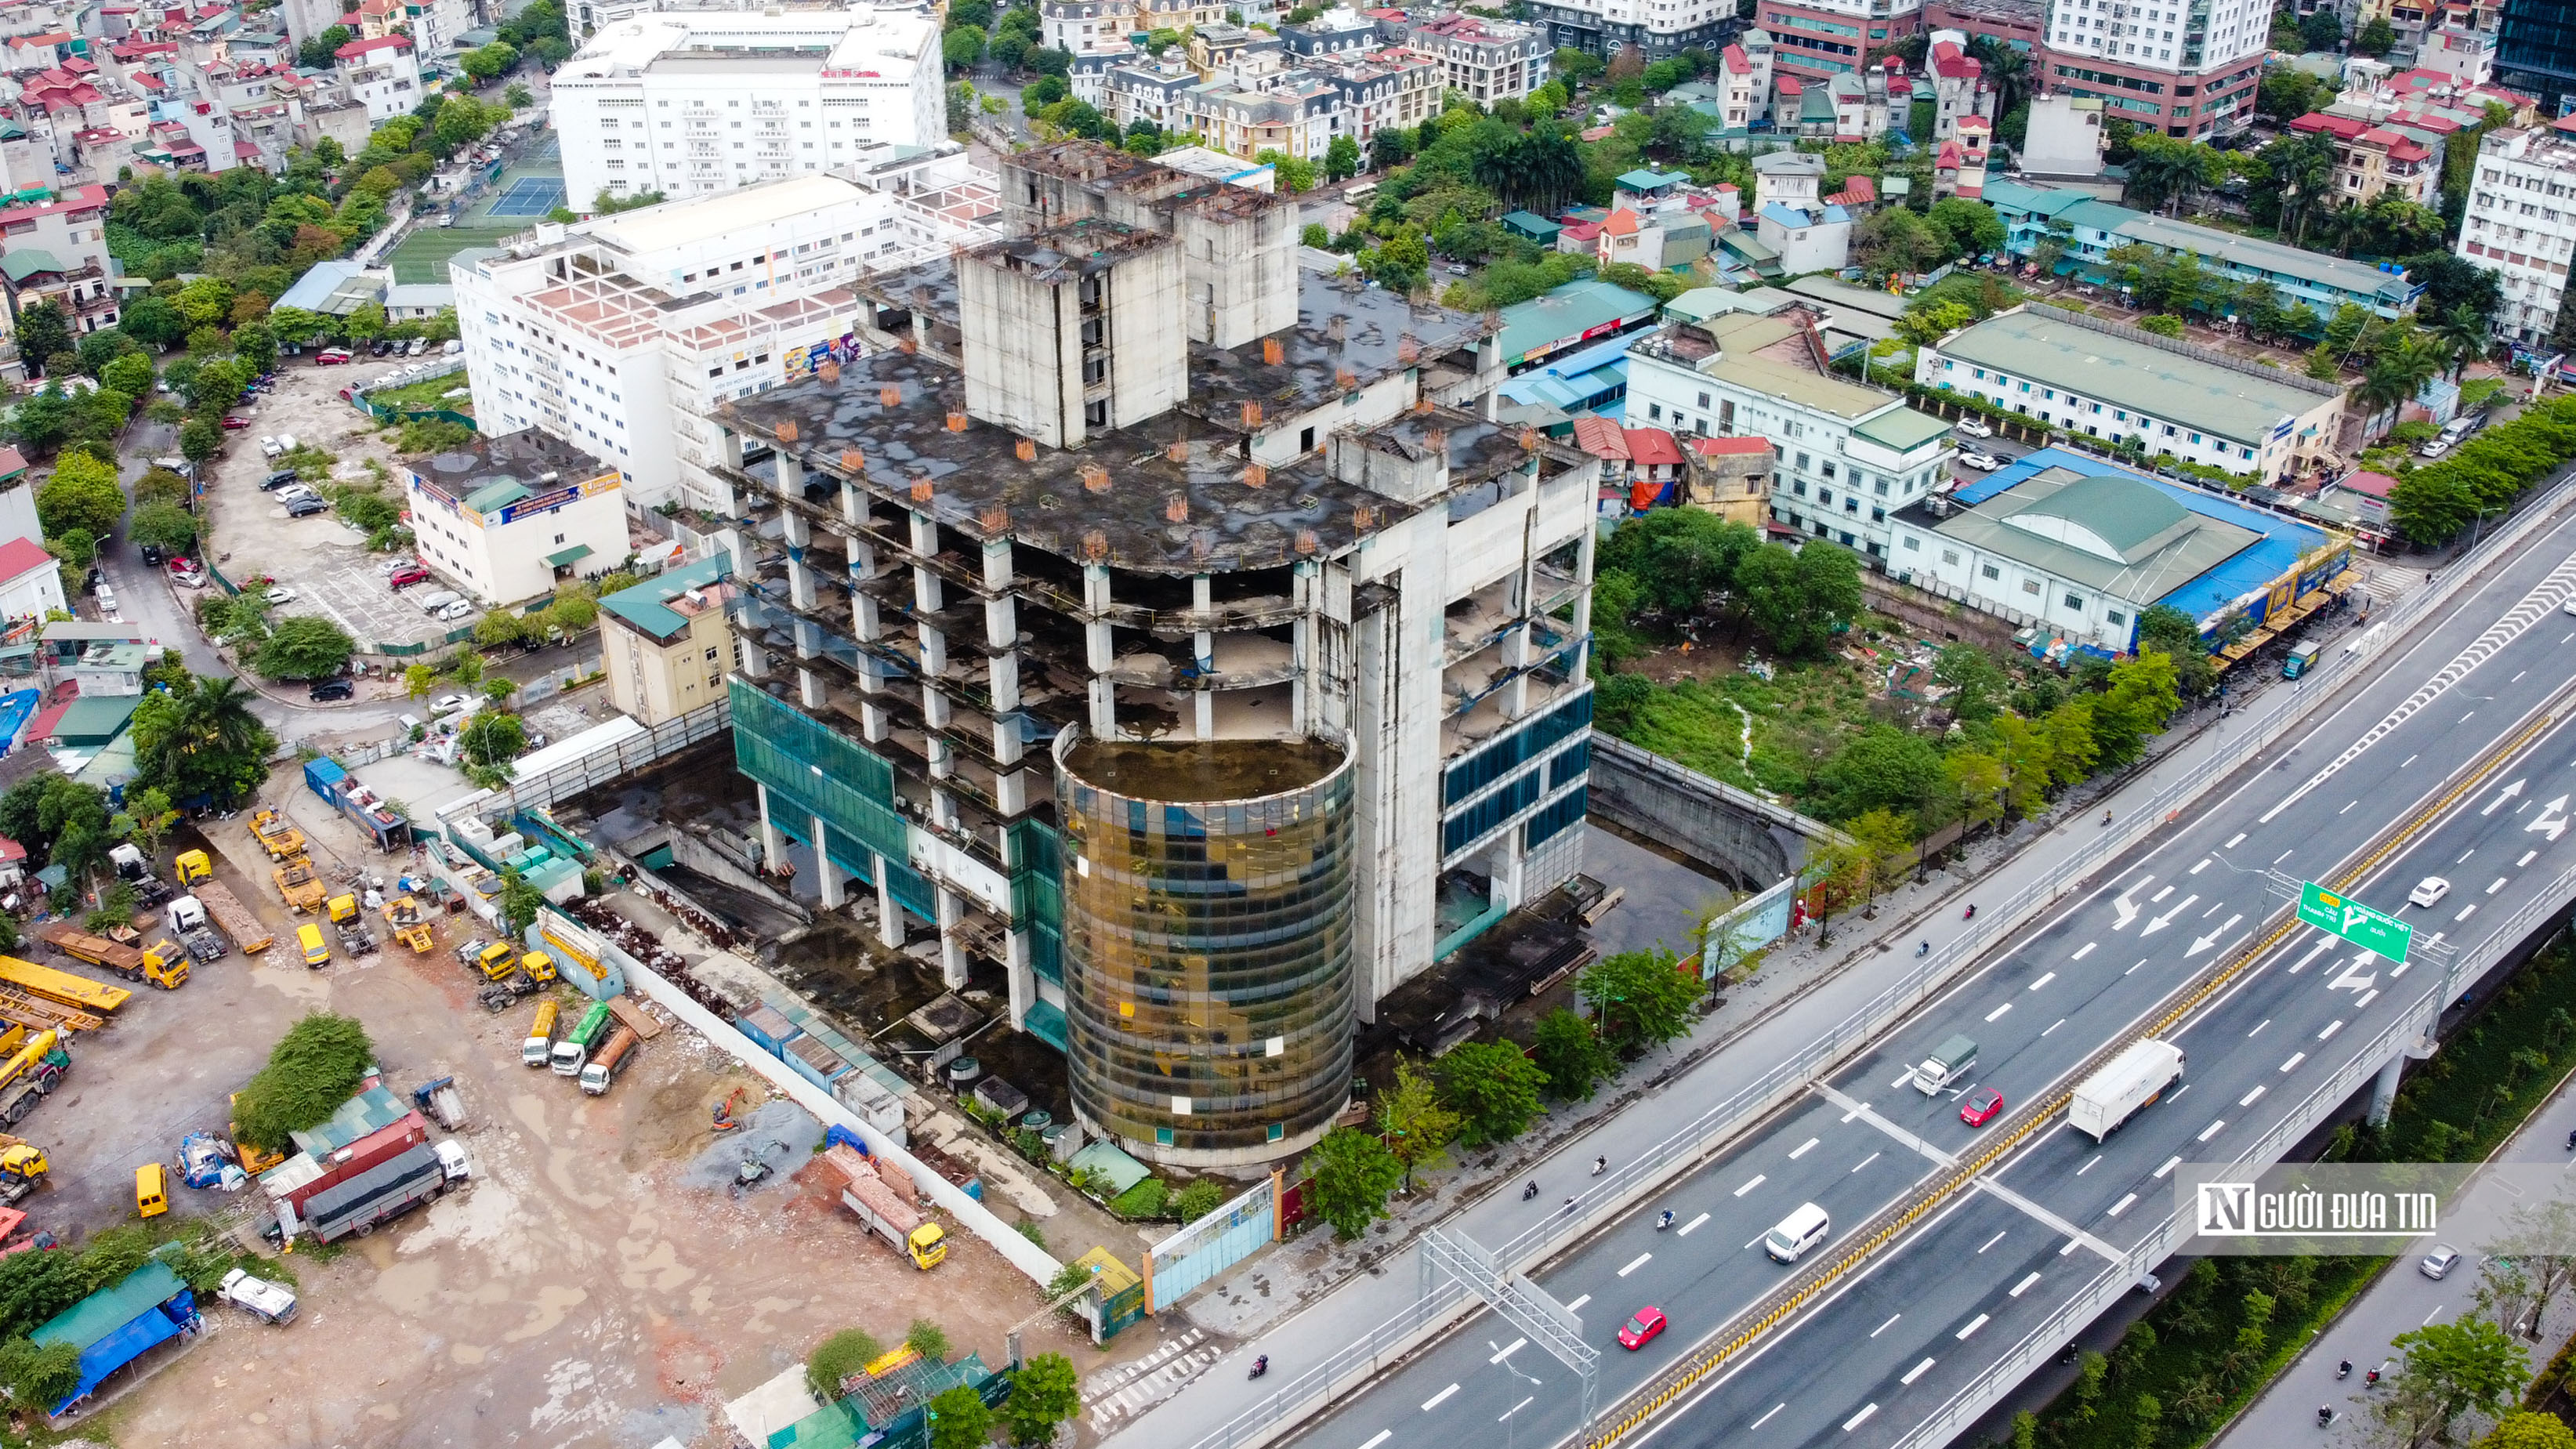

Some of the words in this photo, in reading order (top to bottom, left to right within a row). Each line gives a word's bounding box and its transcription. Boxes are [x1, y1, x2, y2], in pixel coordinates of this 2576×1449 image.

[1560, 335, 1578, 345] TOTAL
[2353, 904, 2375, 918] HOÀNG
[2375, 913, 2393, 927] QUỐC
[2393, 921, 2410, 933] VIỆT
